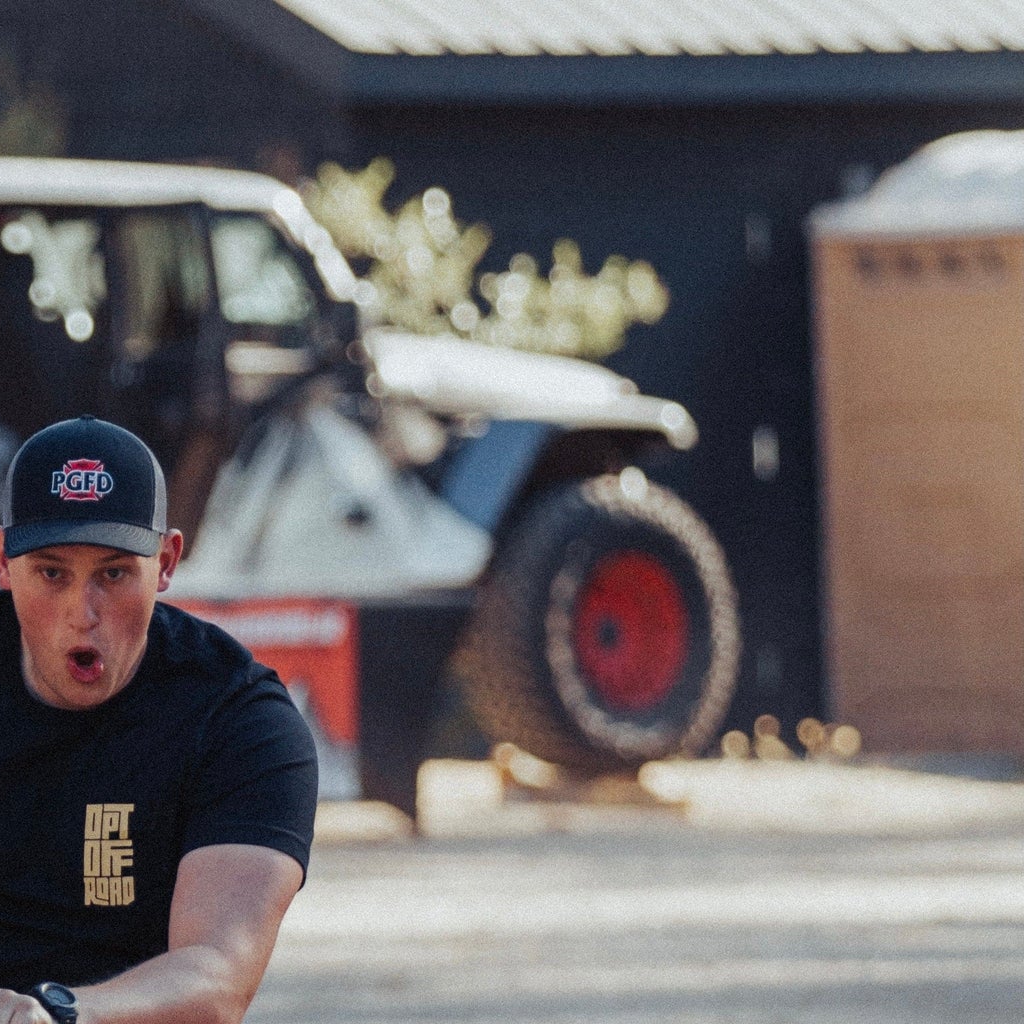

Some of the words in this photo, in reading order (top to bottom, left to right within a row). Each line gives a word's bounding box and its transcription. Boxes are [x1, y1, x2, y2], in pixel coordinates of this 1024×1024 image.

[51, 470, 113, 494] PGFD
[83, 839, 134, 877] OFF
[83, 876, 135, 906] ROAD
